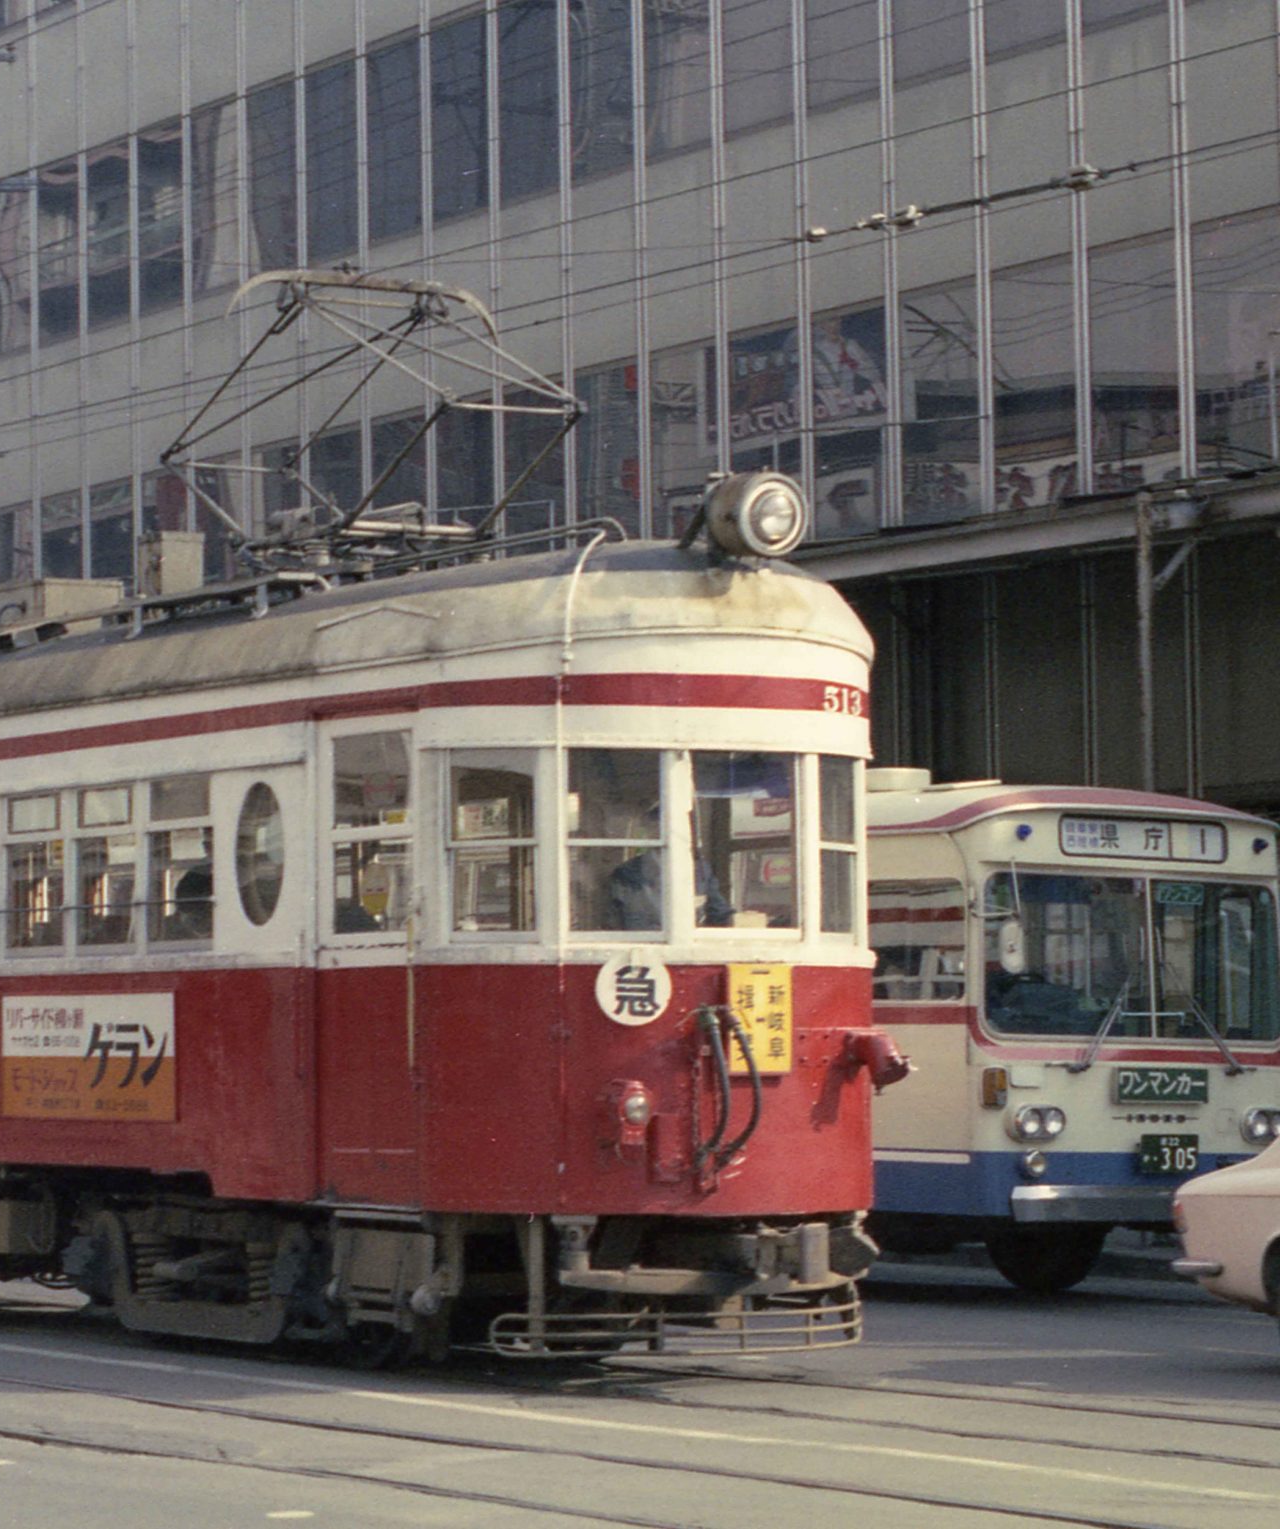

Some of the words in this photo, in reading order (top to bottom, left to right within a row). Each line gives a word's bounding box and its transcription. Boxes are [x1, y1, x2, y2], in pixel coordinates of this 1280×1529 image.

[823, 685, 862, 717] 513
[613, 965, 661, 1017] 急
[1119, 1071, 1206, 1096] ワンマンカー
